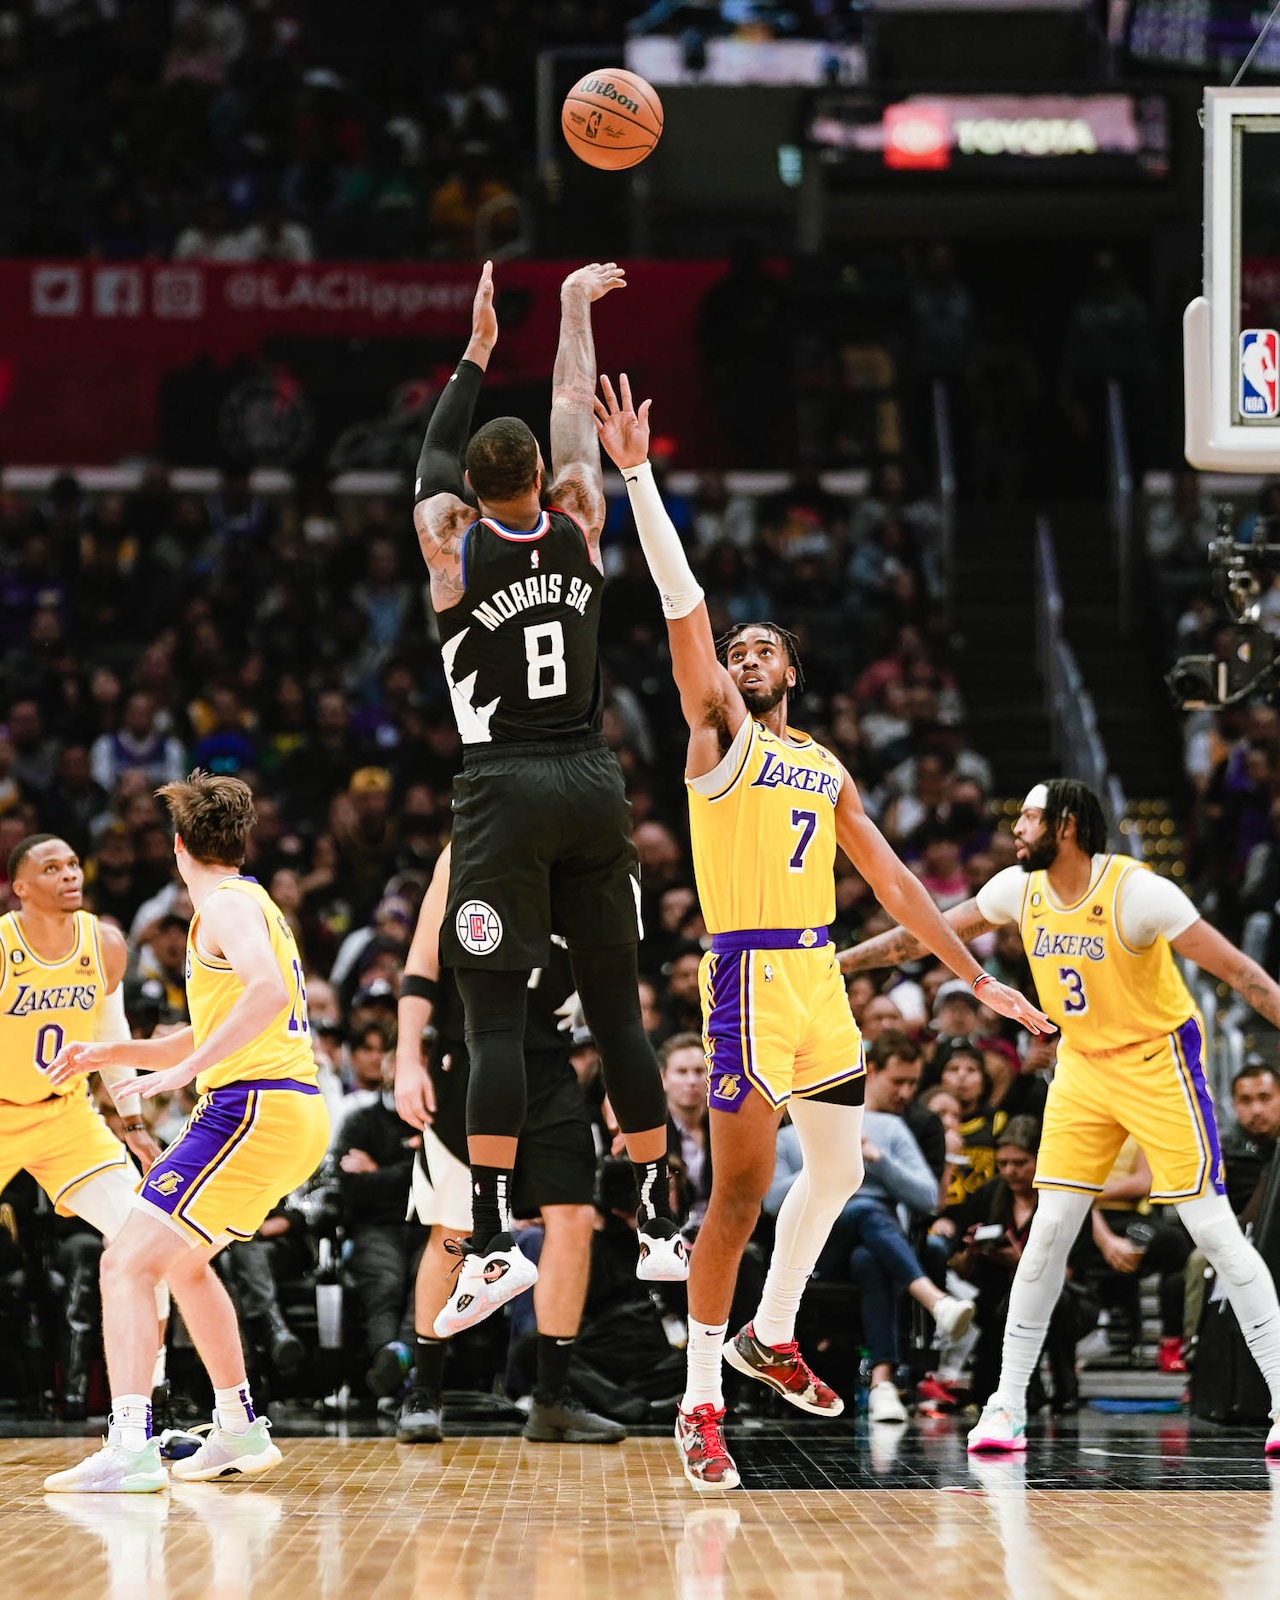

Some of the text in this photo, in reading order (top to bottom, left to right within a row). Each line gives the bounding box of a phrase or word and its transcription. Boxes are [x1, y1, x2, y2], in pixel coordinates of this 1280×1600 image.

[580, 79, 639, 115] Wilson
[955, 118, 1097, 155] TOYOTA
[471, 574, 562, 631] MORRIS
[523, 620, 567, 700] 8
[751, 751, 839, 806] LAKERS
[788, 808, 818, 873] 7
[1031, 927, 1105, 961] LAKERS
[4, 984, 96, 1017] LAKERS
[1059, 966, 1088, 1014] 3
[34, 1023, 65, 1074] 0
